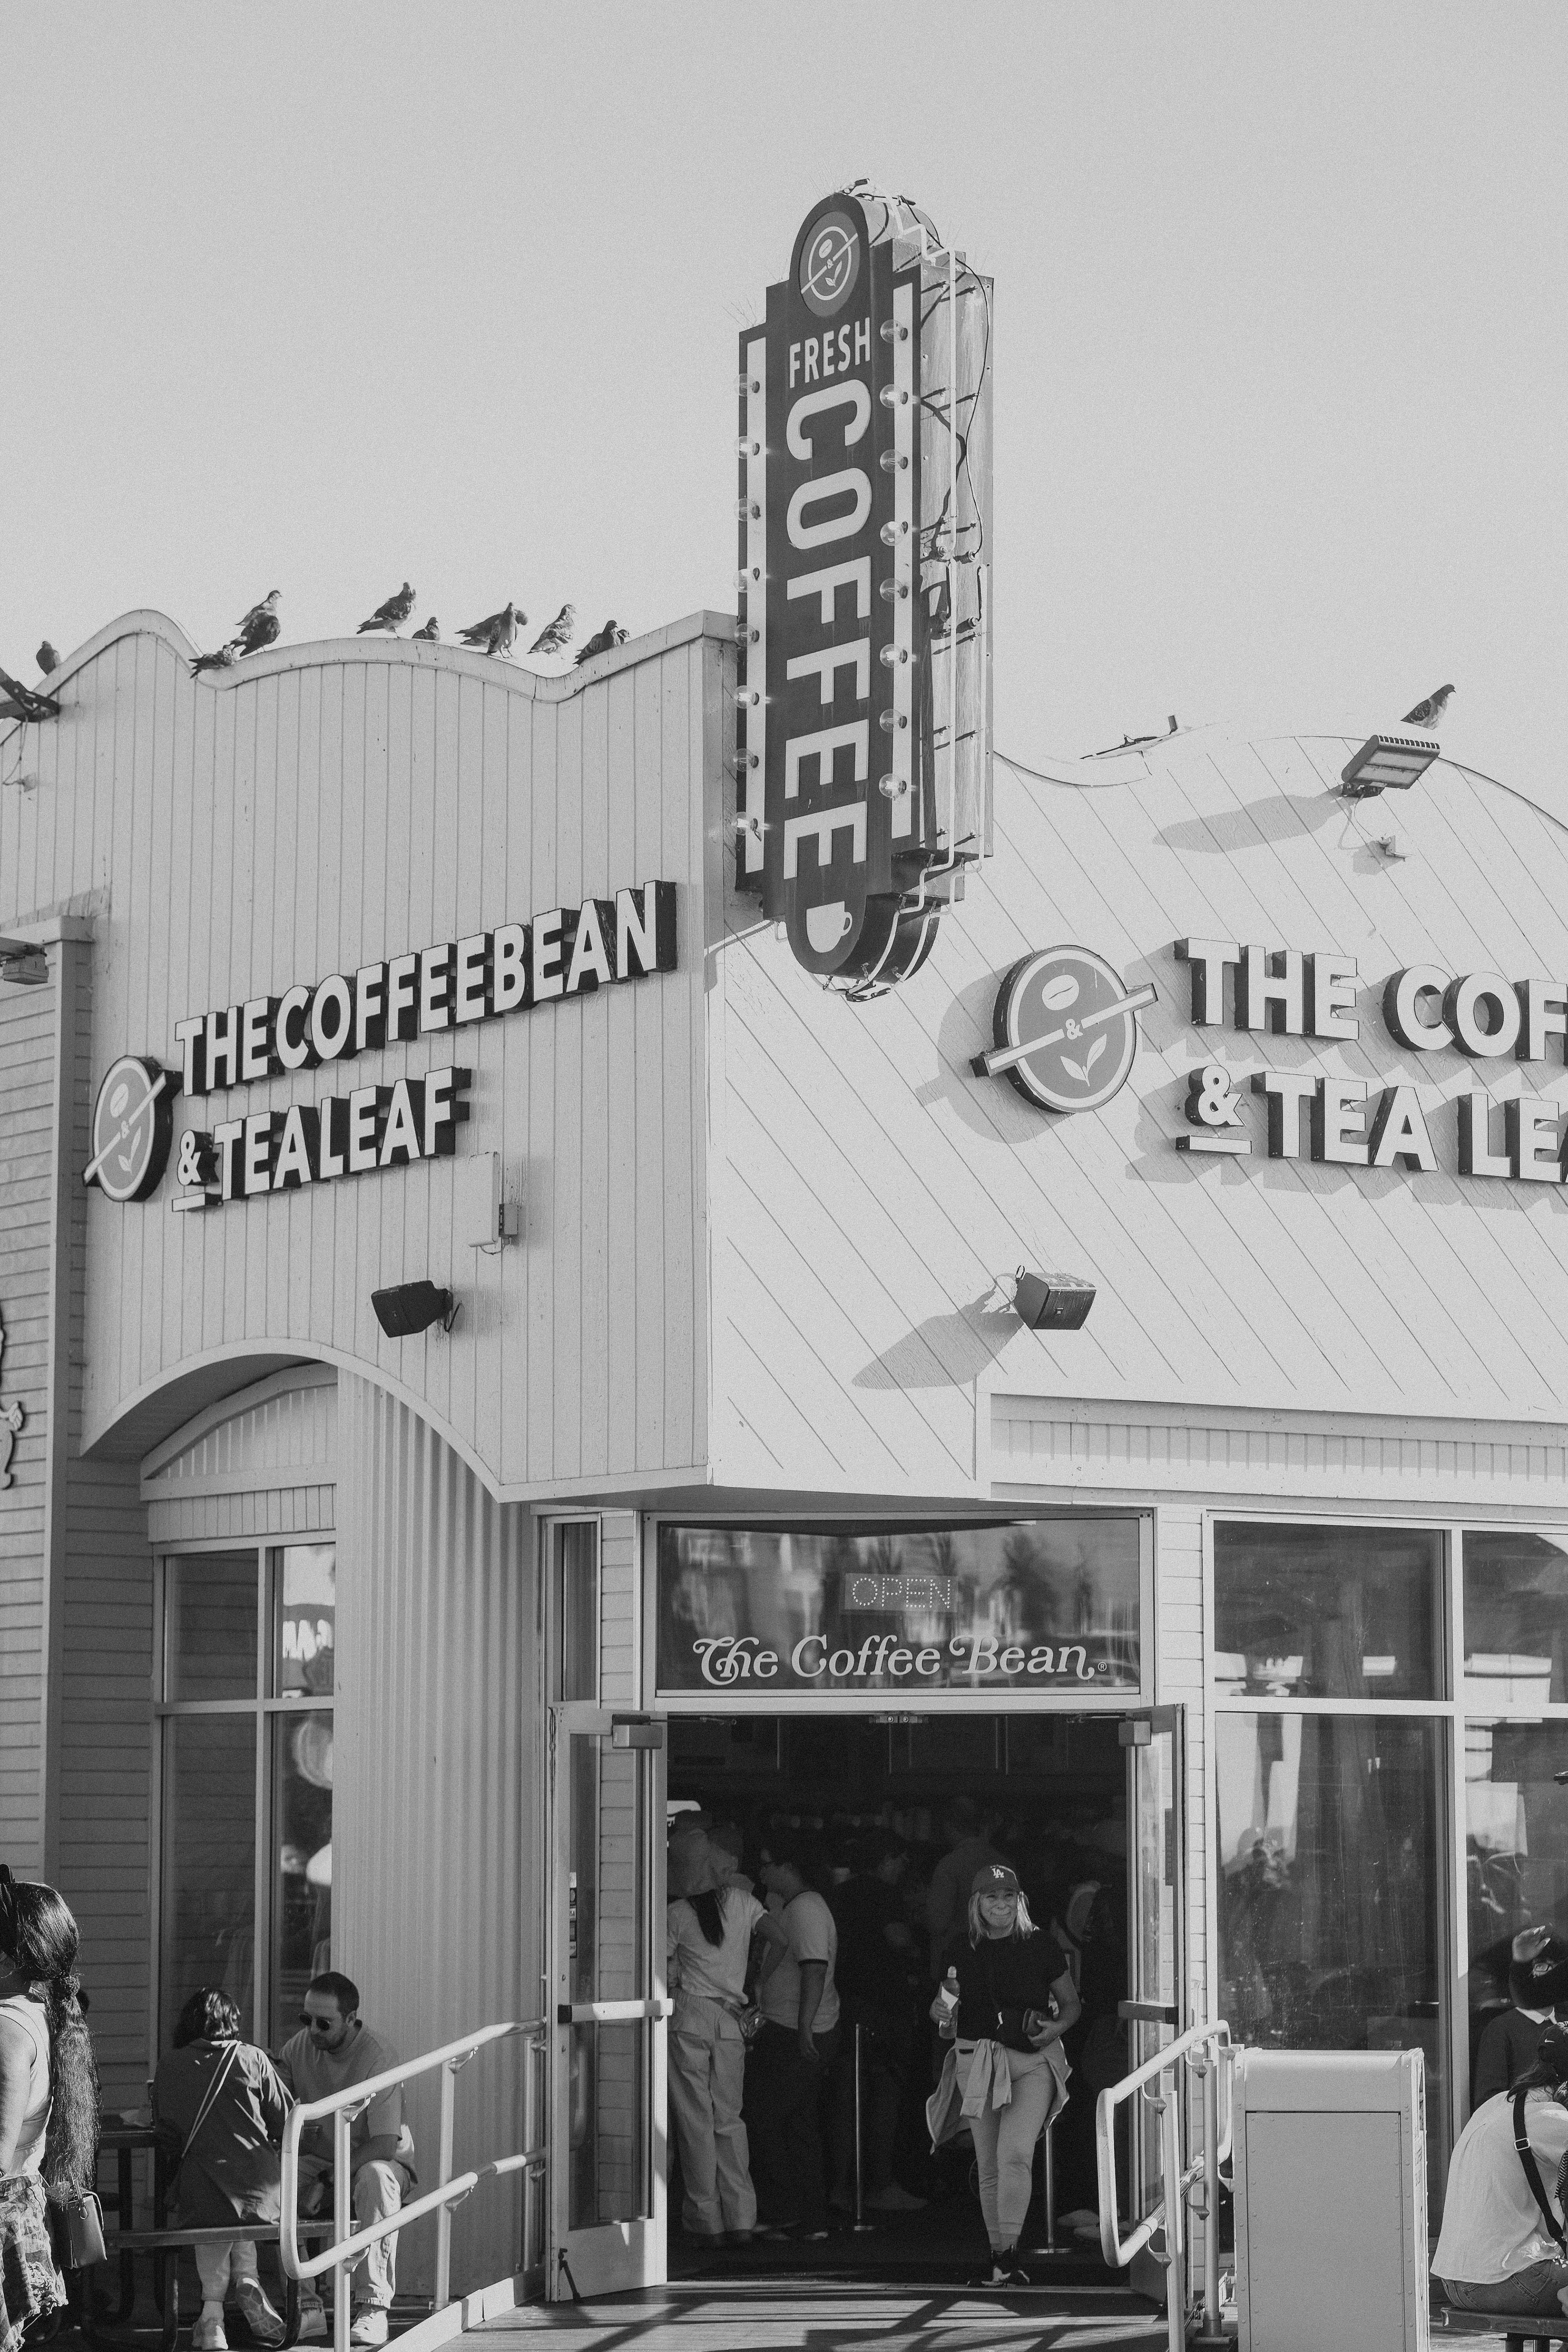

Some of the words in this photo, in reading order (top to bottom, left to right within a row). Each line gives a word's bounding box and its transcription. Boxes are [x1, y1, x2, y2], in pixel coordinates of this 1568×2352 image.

[789, 318, 870, 388] FRESH
[784, 379, 872, 879] COFFEE
[1065, 1018, 1084, 1040] &
[1175, 938, 1359, 1040] THE
[1383, 964, 1568, 1064] COF
[1186, 1065, 1246, 1127] &
[1252, 1071, 1439, 1172] TEA
[1458, 1093, 1568, 1183] LE
[177, 1130, 216, 1187] &
[852, 1577, 951, 1609] OPEN
[693, 1636, 778, 1686] The
[791, 1635, 941, 1677] Coffee
[950, 1636, 1095, 1679] Bean
[991, 1868, 1004, 1878] LA
